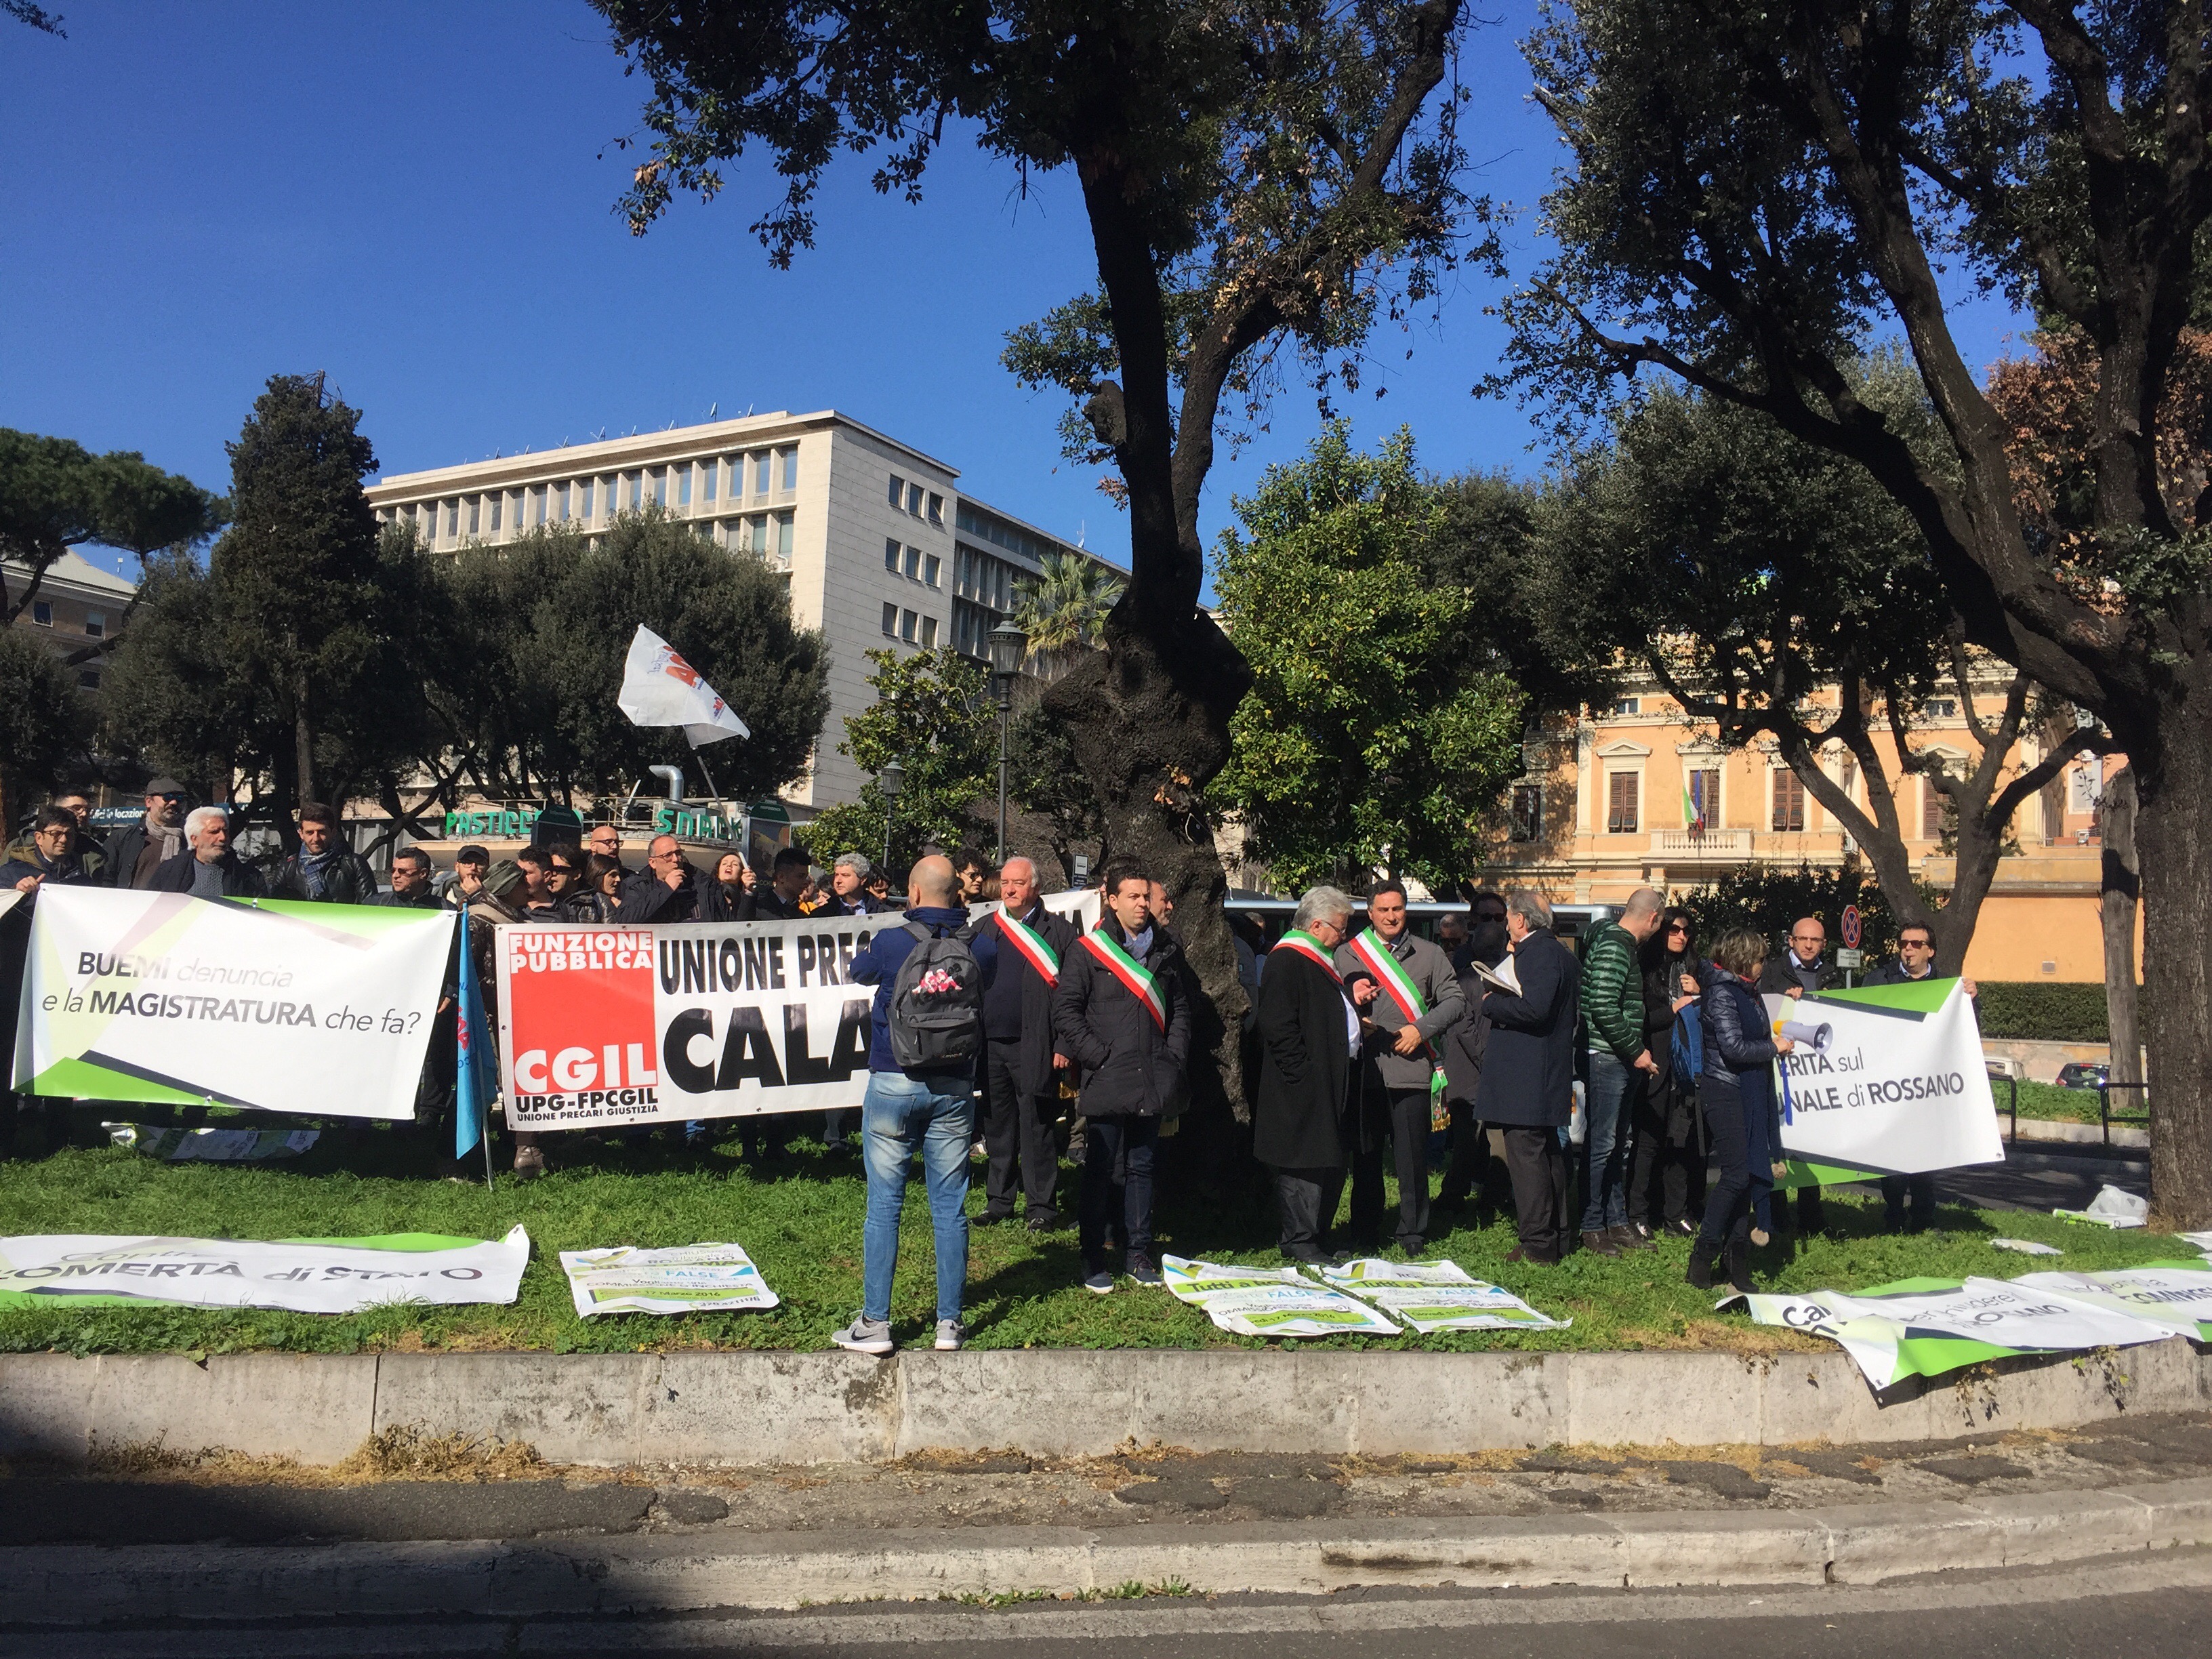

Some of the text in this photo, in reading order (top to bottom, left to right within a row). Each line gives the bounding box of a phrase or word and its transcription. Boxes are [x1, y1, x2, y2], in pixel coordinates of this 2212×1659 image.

[655, 808, 742, 840] SNACK
[509, 933, 653, 954] FUNZIONE
[77, 951, 293, 989] BUEMI denuncia
[510, 951, 653, 974] PUBBLICA
[659, 936, 786, 995] UNIONE
[42, 987, 422, 1035] e la MAGISTRATURA che fa?
[514, 1042, 658, 1094] CGIL
[1837, 1046, 1864, 1073] sul
[516, 1087, 659, 1113] UPG-FPCGIL
[1847, 1084, 1865, 1107] di
[1866, 1072, 1965, 1105] ROSSANO
[517, 1105, 659, 1122] UNIONE PRECARI GIUSTIZIA
[263, 1267, 316, 1282] di
[1187, 1281, 1235, 1292] Tutti
